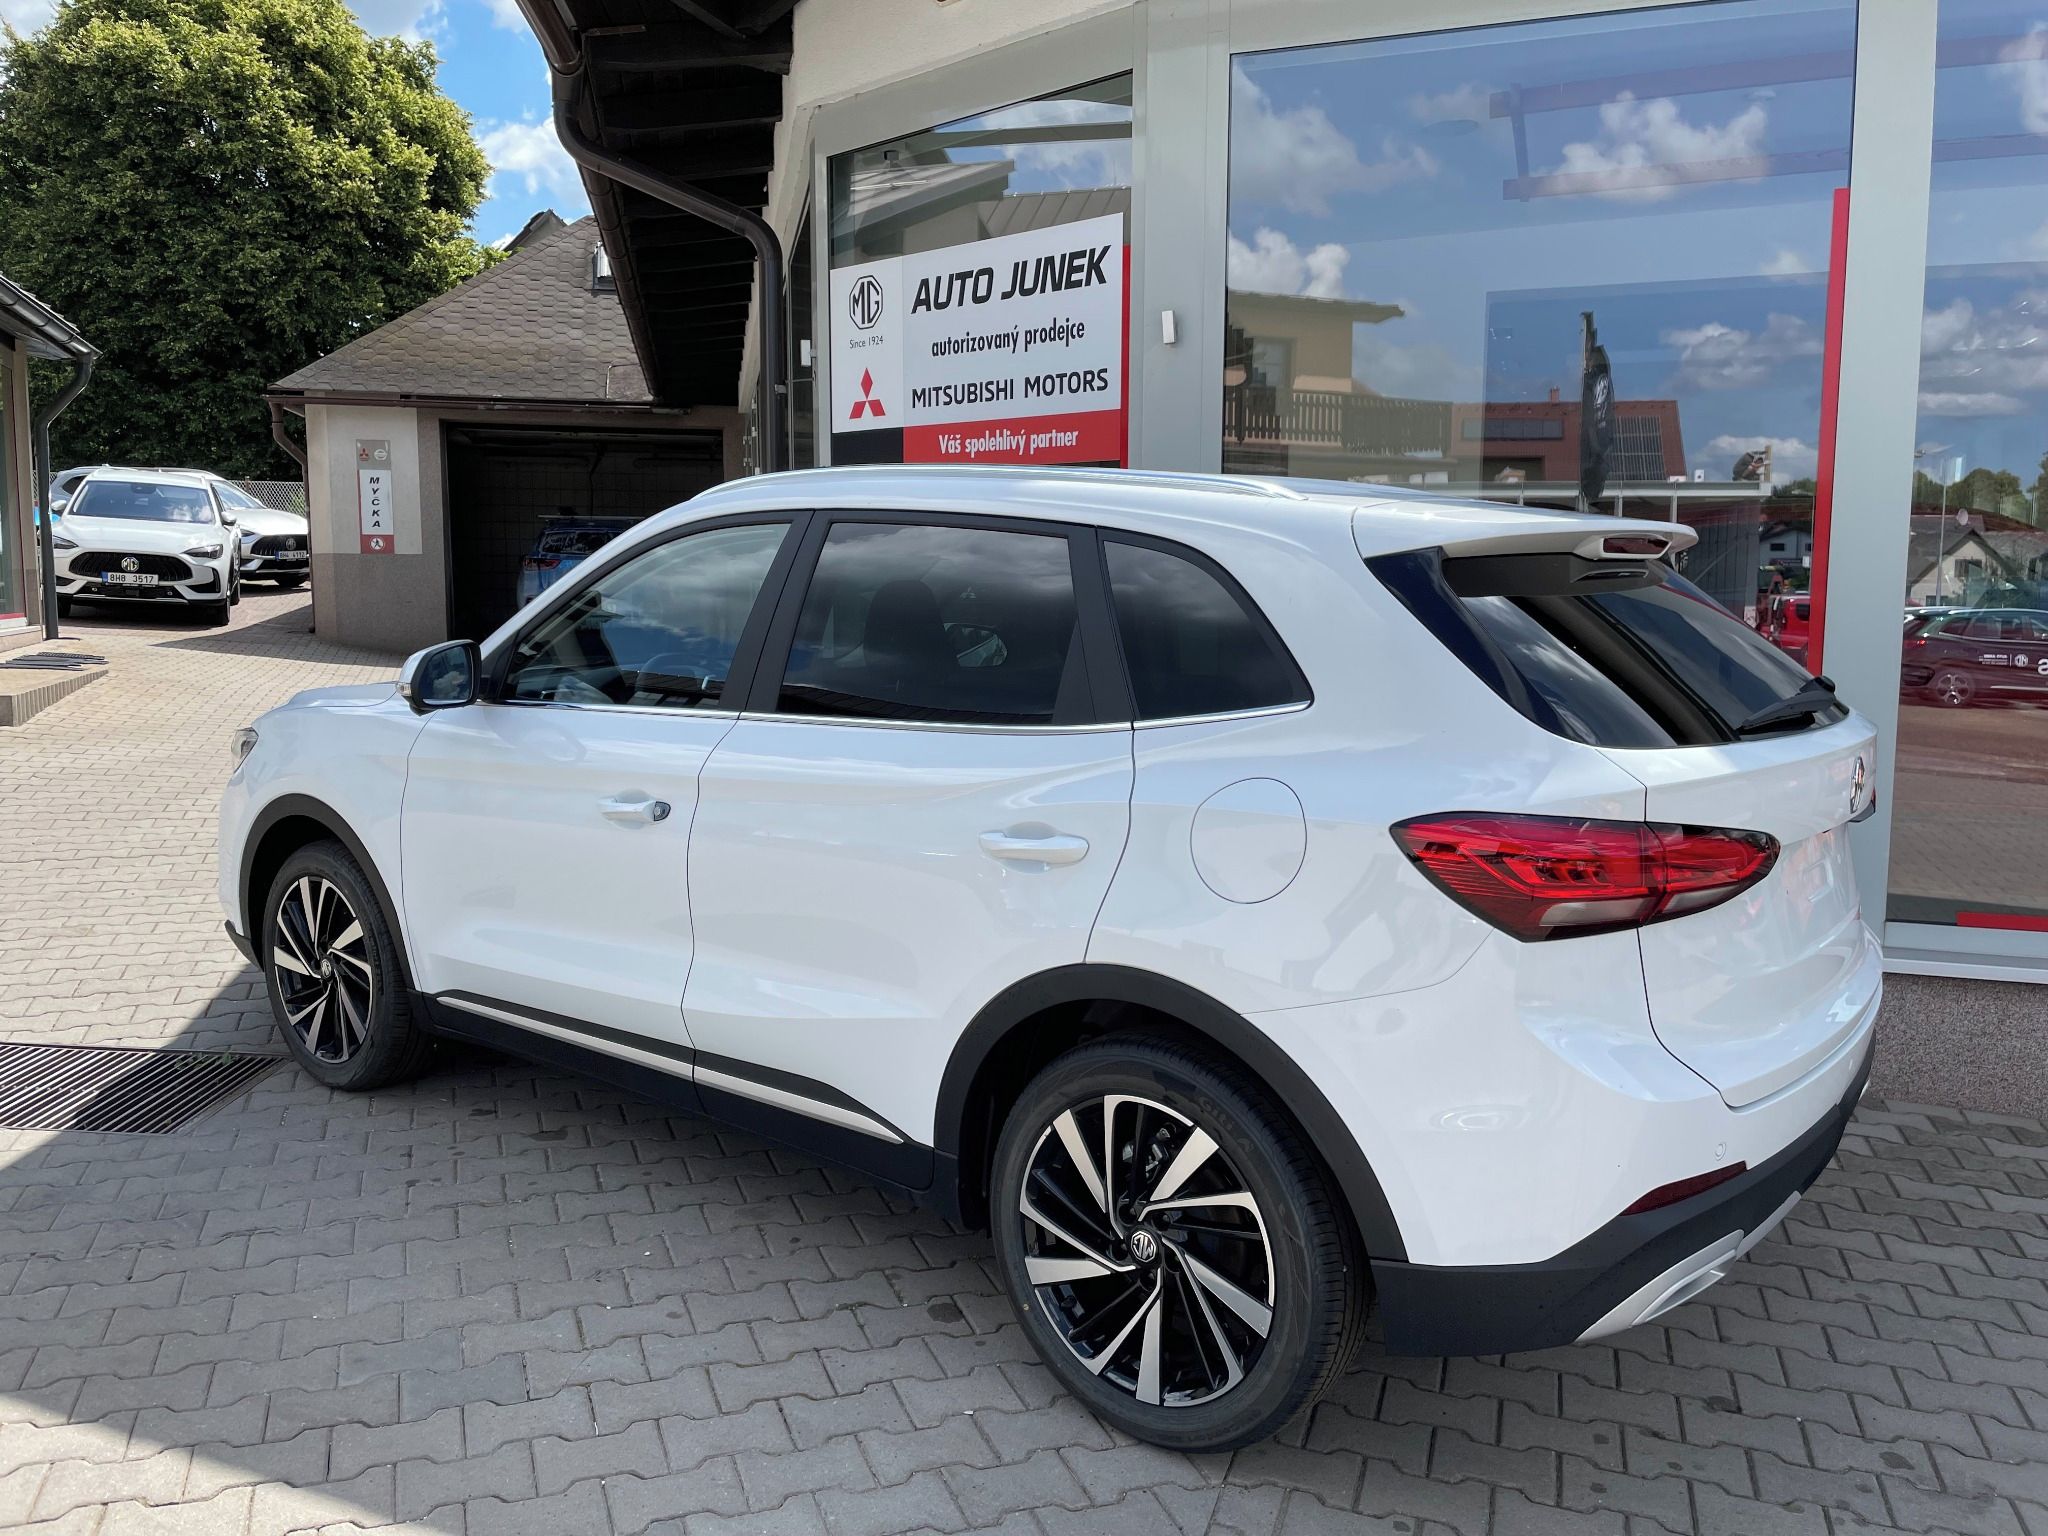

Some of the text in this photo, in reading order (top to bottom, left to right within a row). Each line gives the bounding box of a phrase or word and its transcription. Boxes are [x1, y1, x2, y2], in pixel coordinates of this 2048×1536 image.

[911, 244, 1112, 314] AUTO JUNEK
[851, 278, 881, 326] MG
[849, 335, 884, 350] Since 1924
[931, 317, 1085, 356] autorizovaný prodejce
[912, 368, 1109, 409] MITSUBISHI MOTORS
[938, 429, 1079, 458] Váš spolehlivý partner
[122, 557, 139, 572] MG
[132, 575, 154, 583] 3517
